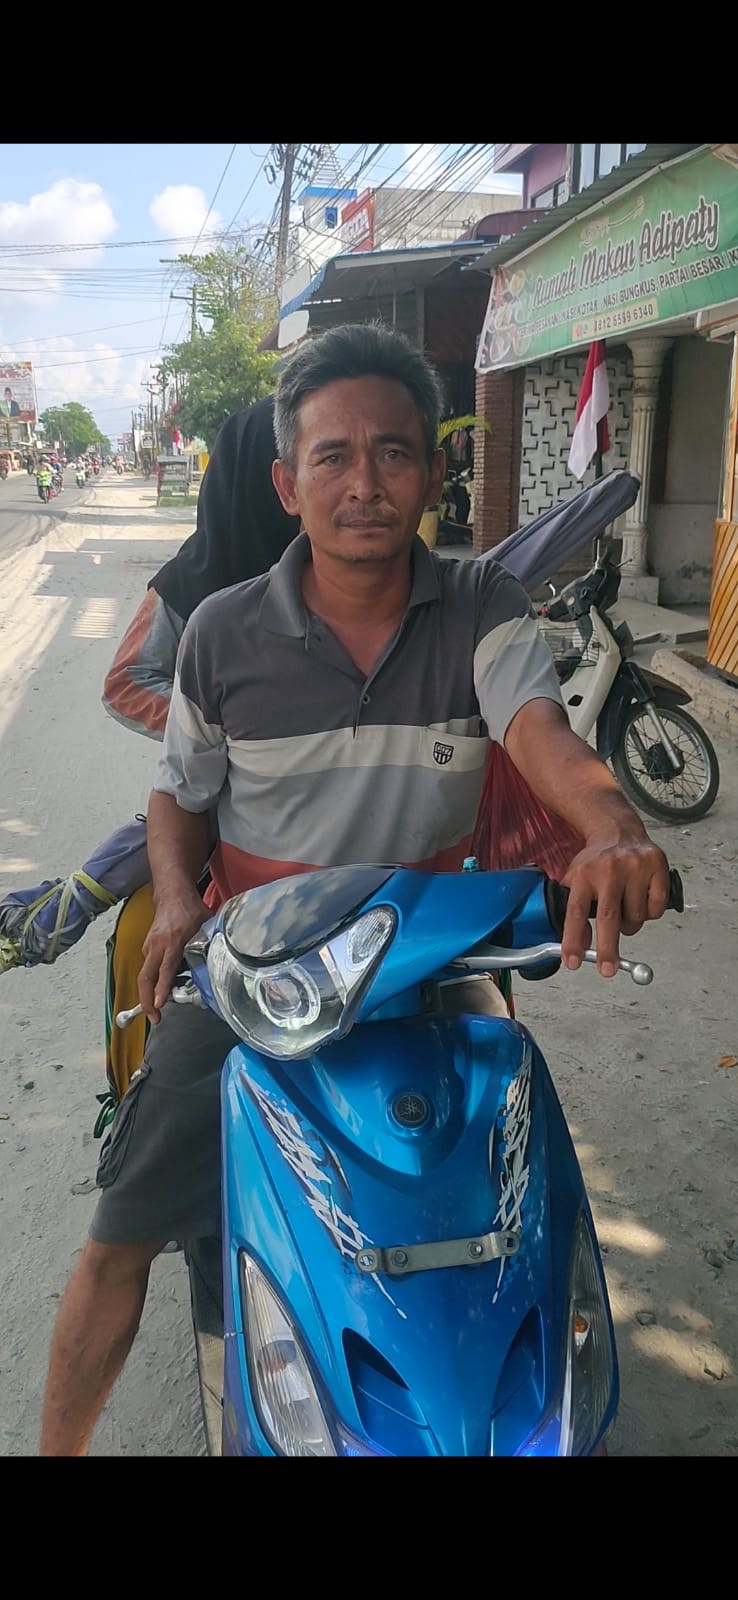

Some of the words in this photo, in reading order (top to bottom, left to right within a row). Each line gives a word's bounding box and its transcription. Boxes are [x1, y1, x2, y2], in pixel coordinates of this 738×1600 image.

[533, 257, 577, 311] Rumah
[579, 239, 635, 290] Makan
[639, 197, 719, 266] Adipaty
[603, 293, 618, 308] NASI
[659, 269, 690, 289] PARTAI
[633, 303, 653, 321] 6340
